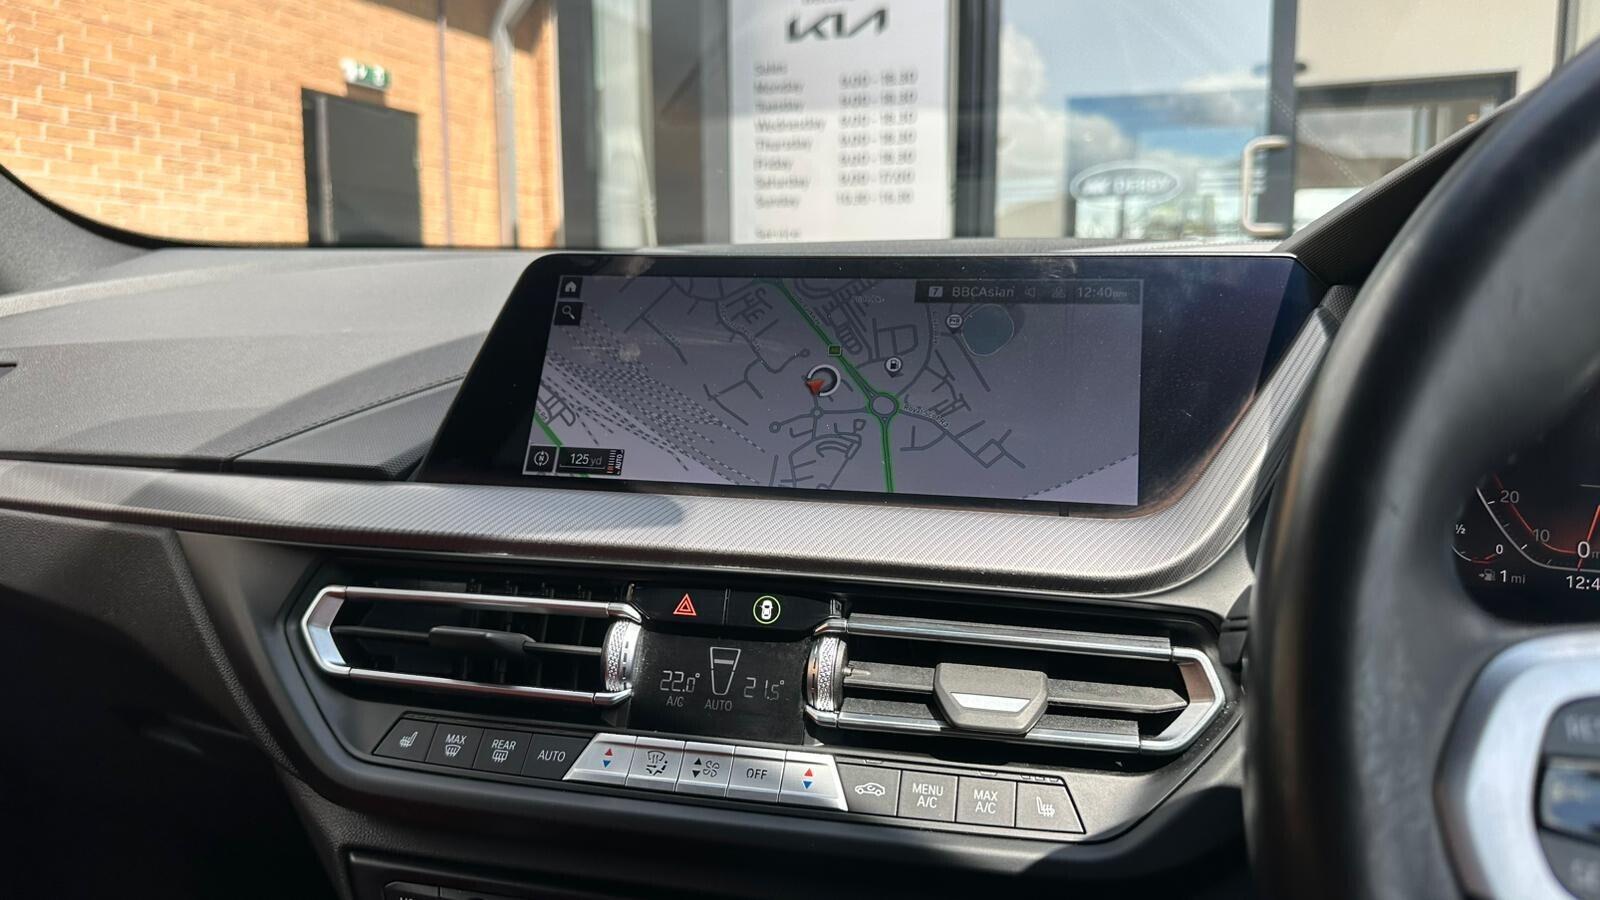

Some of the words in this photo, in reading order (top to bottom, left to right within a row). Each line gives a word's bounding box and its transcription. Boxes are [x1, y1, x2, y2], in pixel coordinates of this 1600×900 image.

[788, 9, 888, 41] KIA
[570, 453, 589, 464] 125
[591, 456, 602, 465] yd
[1500, 490, 1519, 504] 20
[1534, 528, 1550, 542] 10
[1496, 544, 1504, 555] 0
[1577, 541, 1590, 558] 0
[1500, 570, 1507, 583] 1
[1511, 574, 1526, 584] mi
[666, 696, 684, 707] A/C
[704, 699, 733, 712] AUTO
[445, 733, 467, 745] MAX
[491, 739, 516, 751] REAR
[537, 750, 566, 763] AUTO
[746, 768, 767, 780] OFF
[912, 782, 943, 796] MENU
[973, 789, 998, 802] MAX
[917, 796, 937, 809] A/C
[975, 801, 996, 815] A/C
